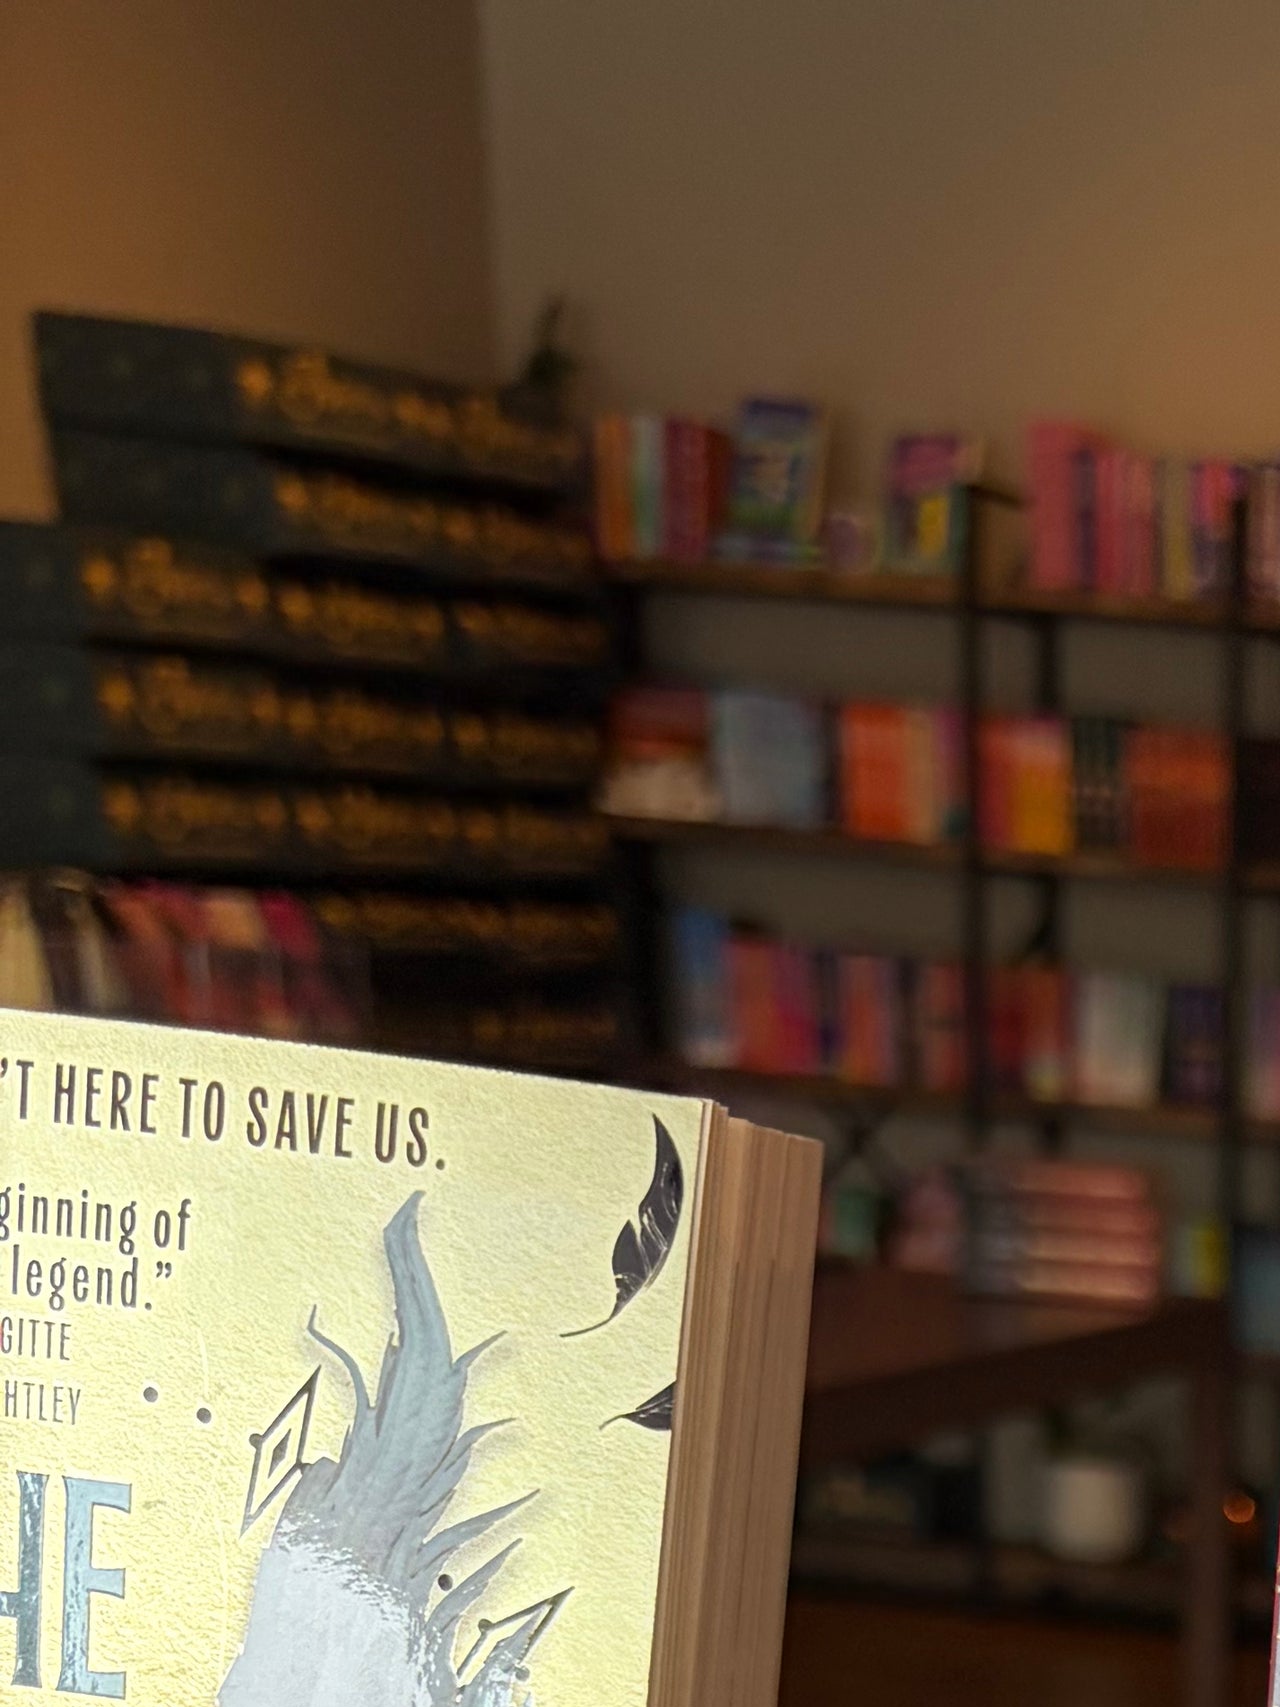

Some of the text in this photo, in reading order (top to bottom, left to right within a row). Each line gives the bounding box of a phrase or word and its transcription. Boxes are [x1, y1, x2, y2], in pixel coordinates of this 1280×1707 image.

[53, 1062, 159, 1135] HERE
[178, 1076, 225, 1142] TO
[246, 1085, 354, 1160] SAVE
[373, 1101, 446, 1171] US.
[153, 1198, 192, 1251] of
[11, 1243, 173, 1312] legend.”
[0, 1316, 72, 1361] GITTE
[4, 1379, 82, 1425] HTLEY
